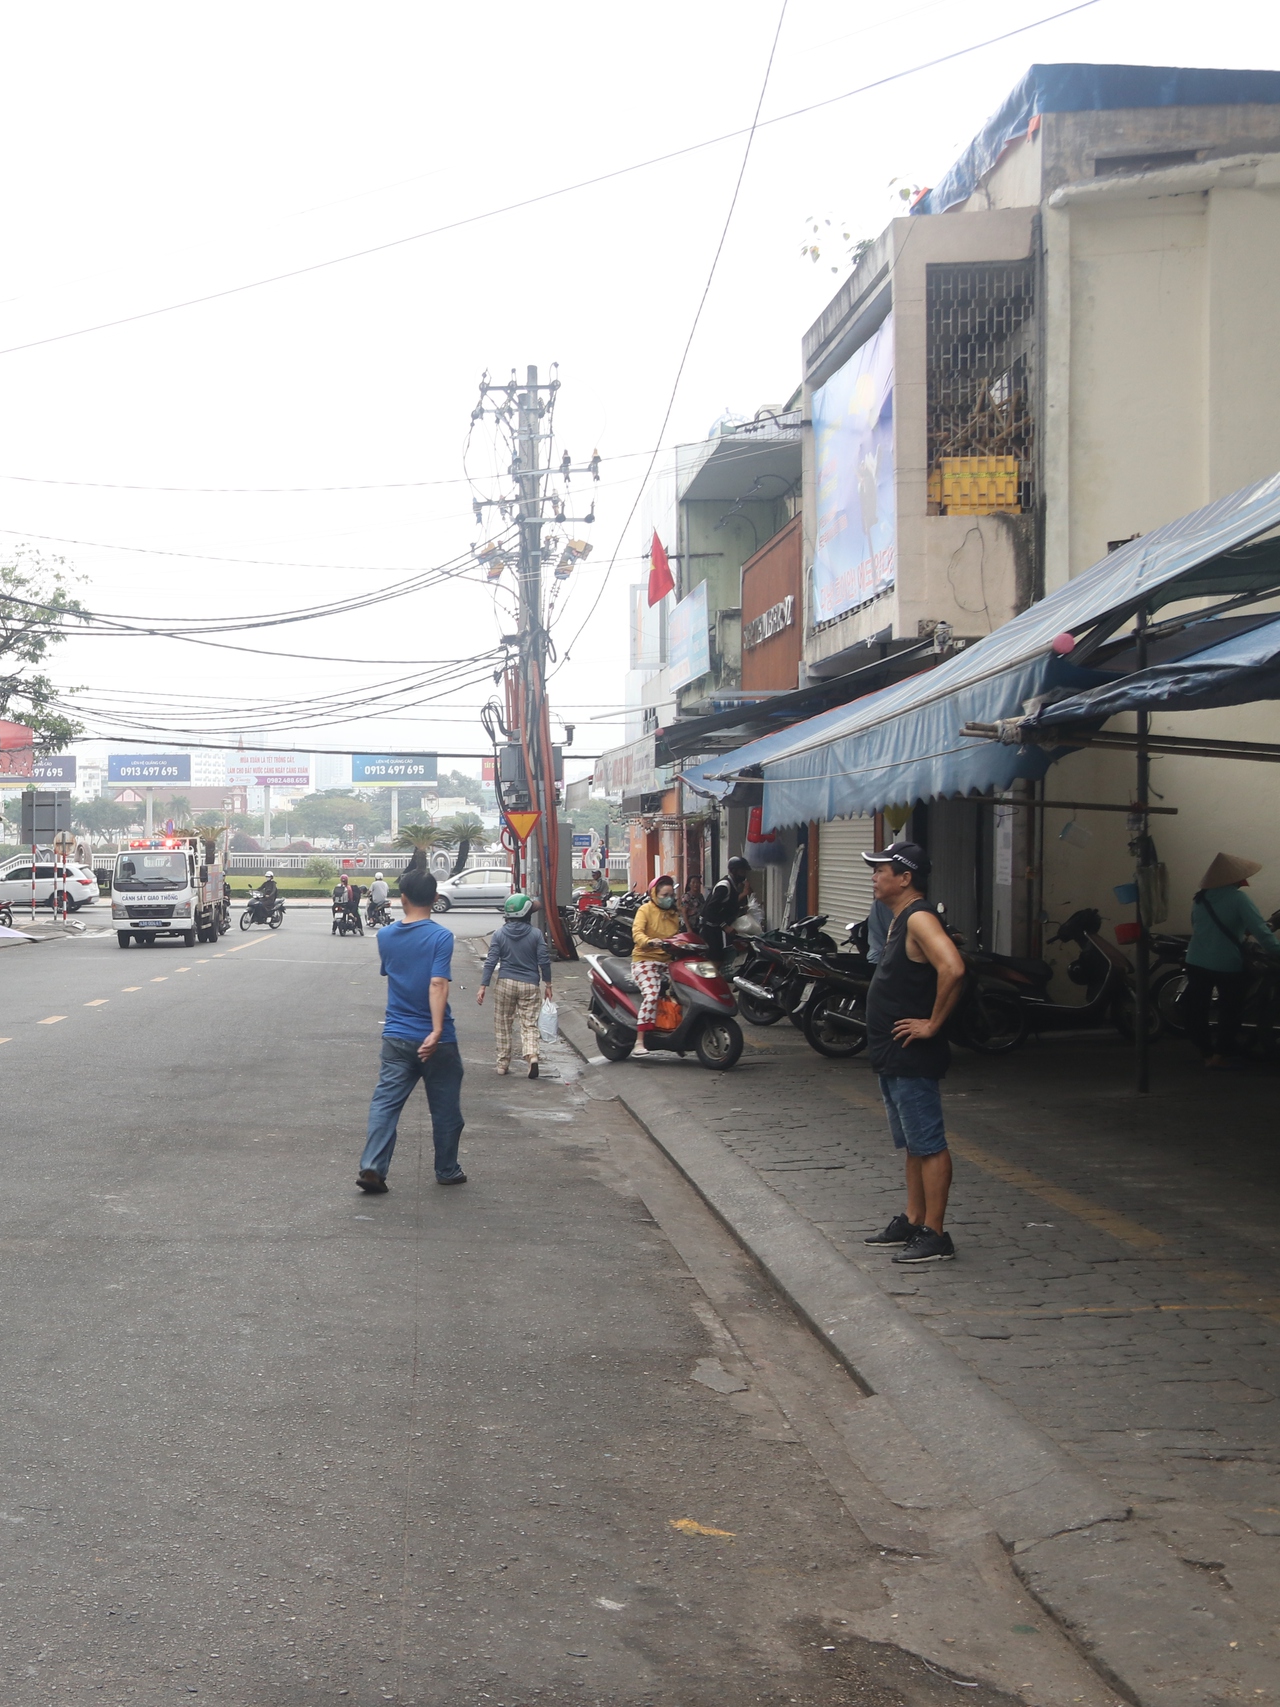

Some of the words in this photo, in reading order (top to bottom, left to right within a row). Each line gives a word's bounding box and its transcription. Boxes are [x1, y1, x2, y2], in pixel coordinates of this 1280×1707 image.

[46, 768, 63, 777] 695
[120, 767, 140, 776] 0913
[142, 767, 160, 776] 497
[161, 767, 178, 776] 695
[364, 765, 386, 775] 0913
[387, 765, 406, 775] 497
[407, 765, 424, 774] 695
[161, 893, 178, 901] THÔNG
